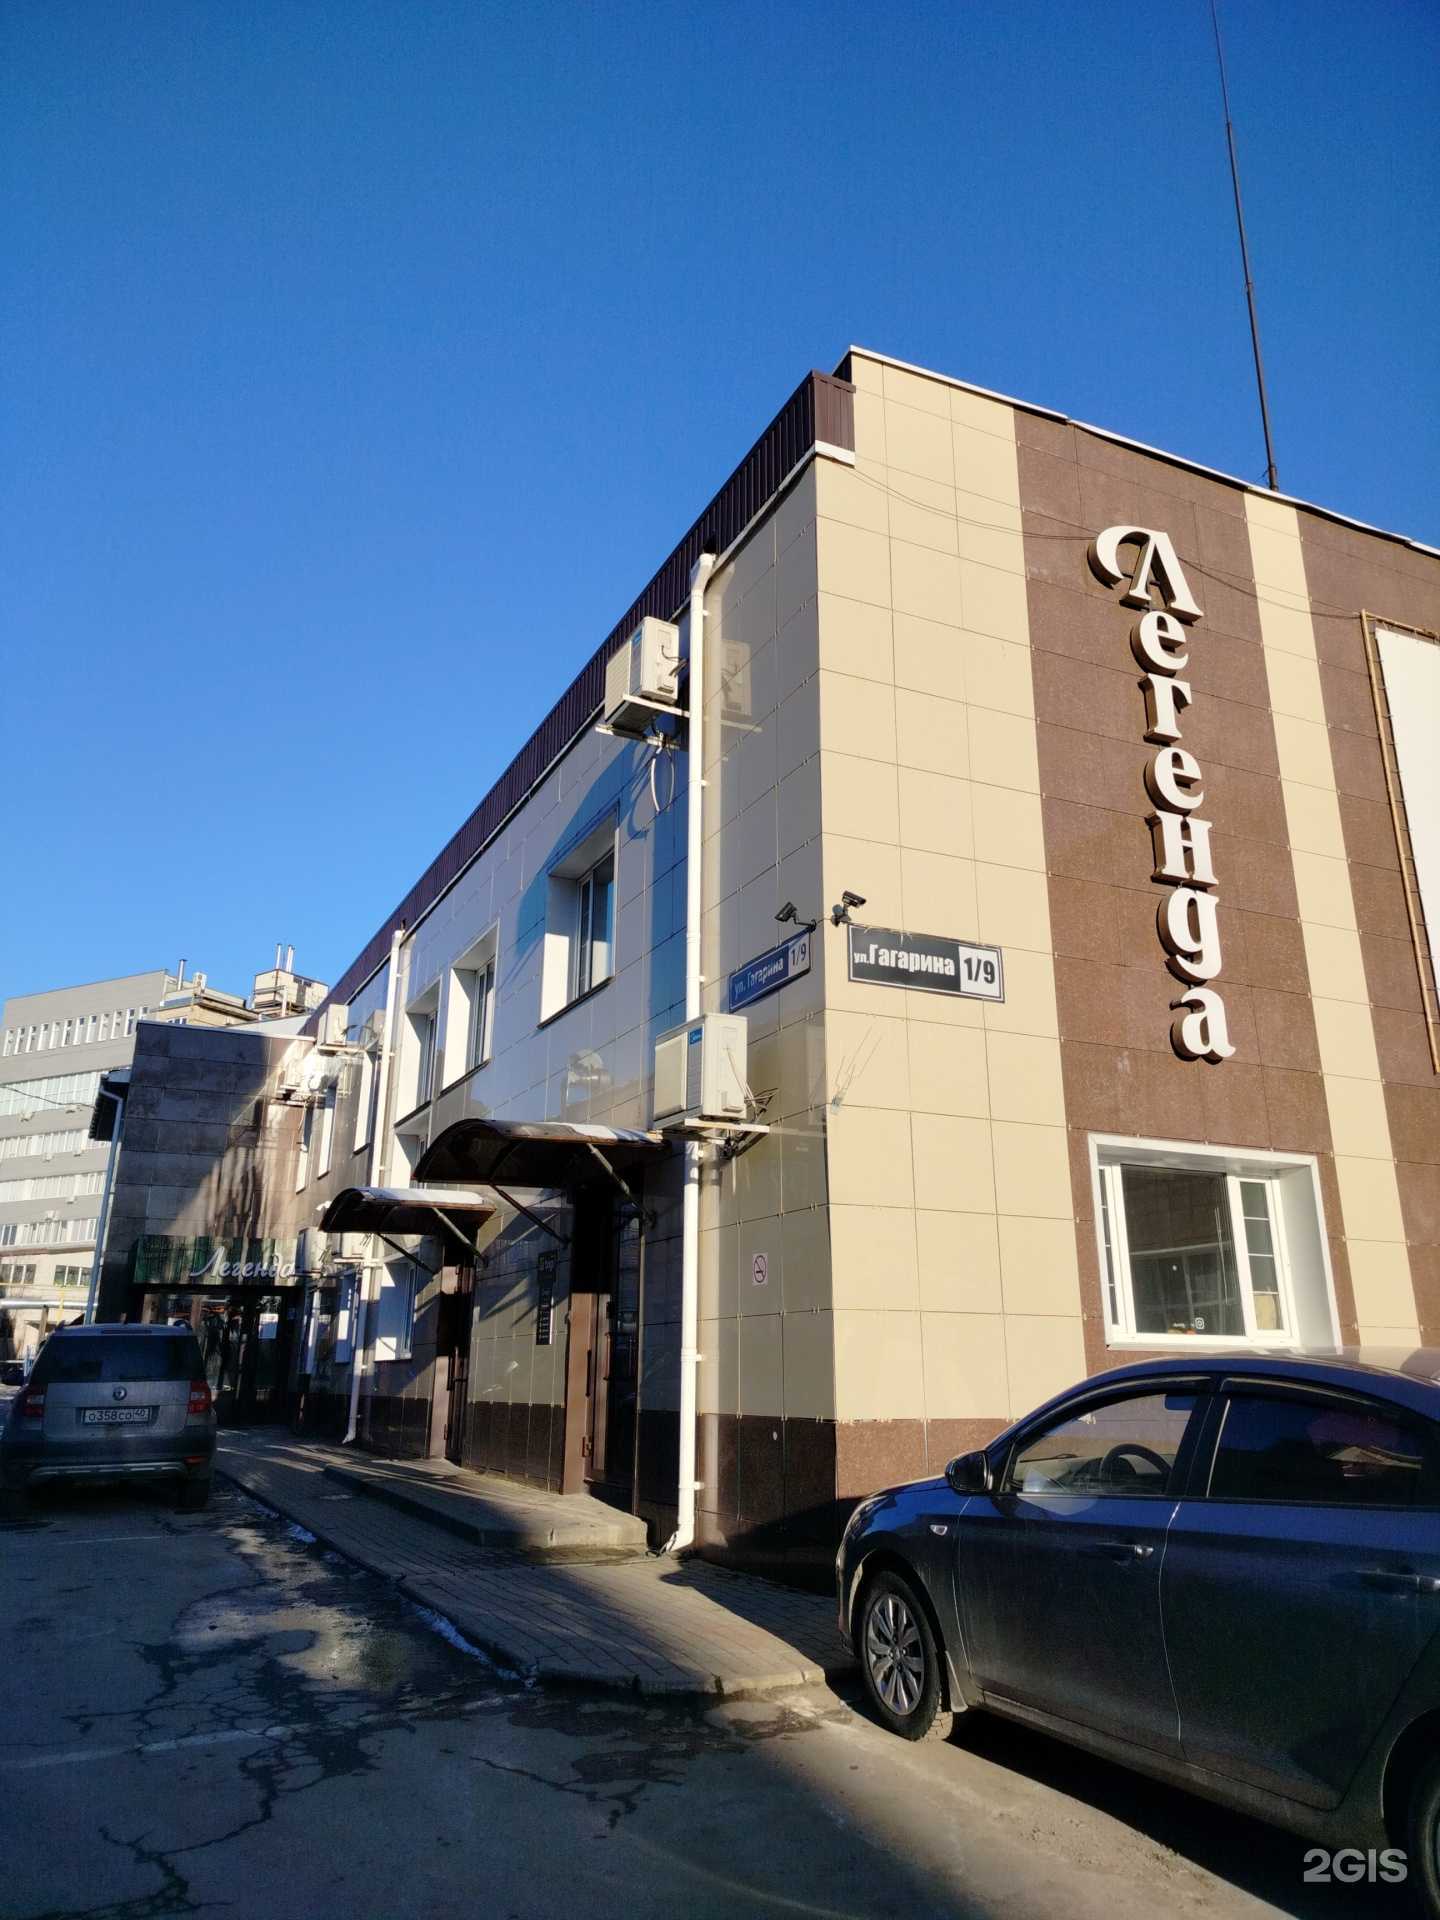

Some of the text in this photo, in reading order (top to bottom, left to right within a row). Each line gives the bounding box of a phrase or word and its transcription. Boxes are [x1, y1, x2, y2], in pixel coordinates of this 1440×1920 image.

[1088, 525, 1236, 1063] Легенда
[747, 957, 784, 988] Гагарина
[791, 943, 807, 966] 1/9
[963, 956, 996, 984] 1/9
[189, 1246, 296, 1279] Легенда
